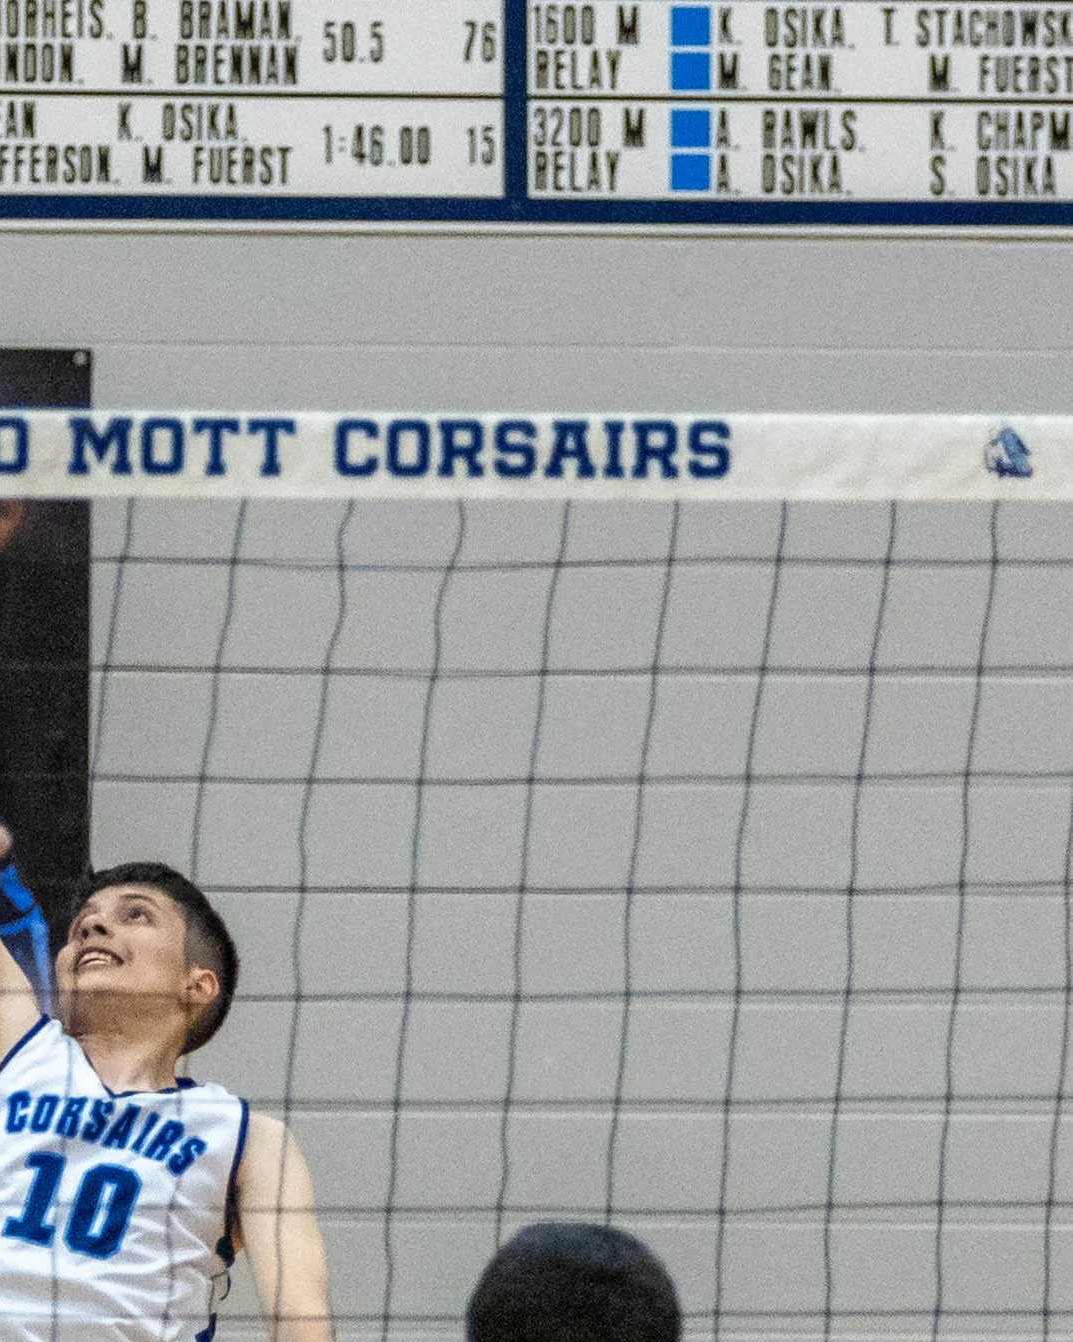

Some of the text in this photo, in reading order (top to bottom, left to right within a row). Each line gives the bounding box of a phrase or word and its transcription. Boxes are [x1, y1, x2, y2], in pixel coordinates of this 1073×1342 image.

[323, 20, 496, 63] 50.5 76
[533, 4, 638, 45] 1600 M
[175, 44, 296, 85] BRENNAN
[536, 49, 622, 90] RELAY
[323, 123, 495, 166] 1:46.00 15
[534, 106, 645, 148] 3200 M
[193, 146, 293, 185] FUERST
[534, 151, 620, 191] RELAY
[977, 155, 1056, 196] OSIKA
[68, 416, 296, 477] MOTT
[334, 418, 731, 480] CORSAIRS
[4, 1090, 208, 1177] CORSAIRS
[1, 1150, 143, 1261] 10
